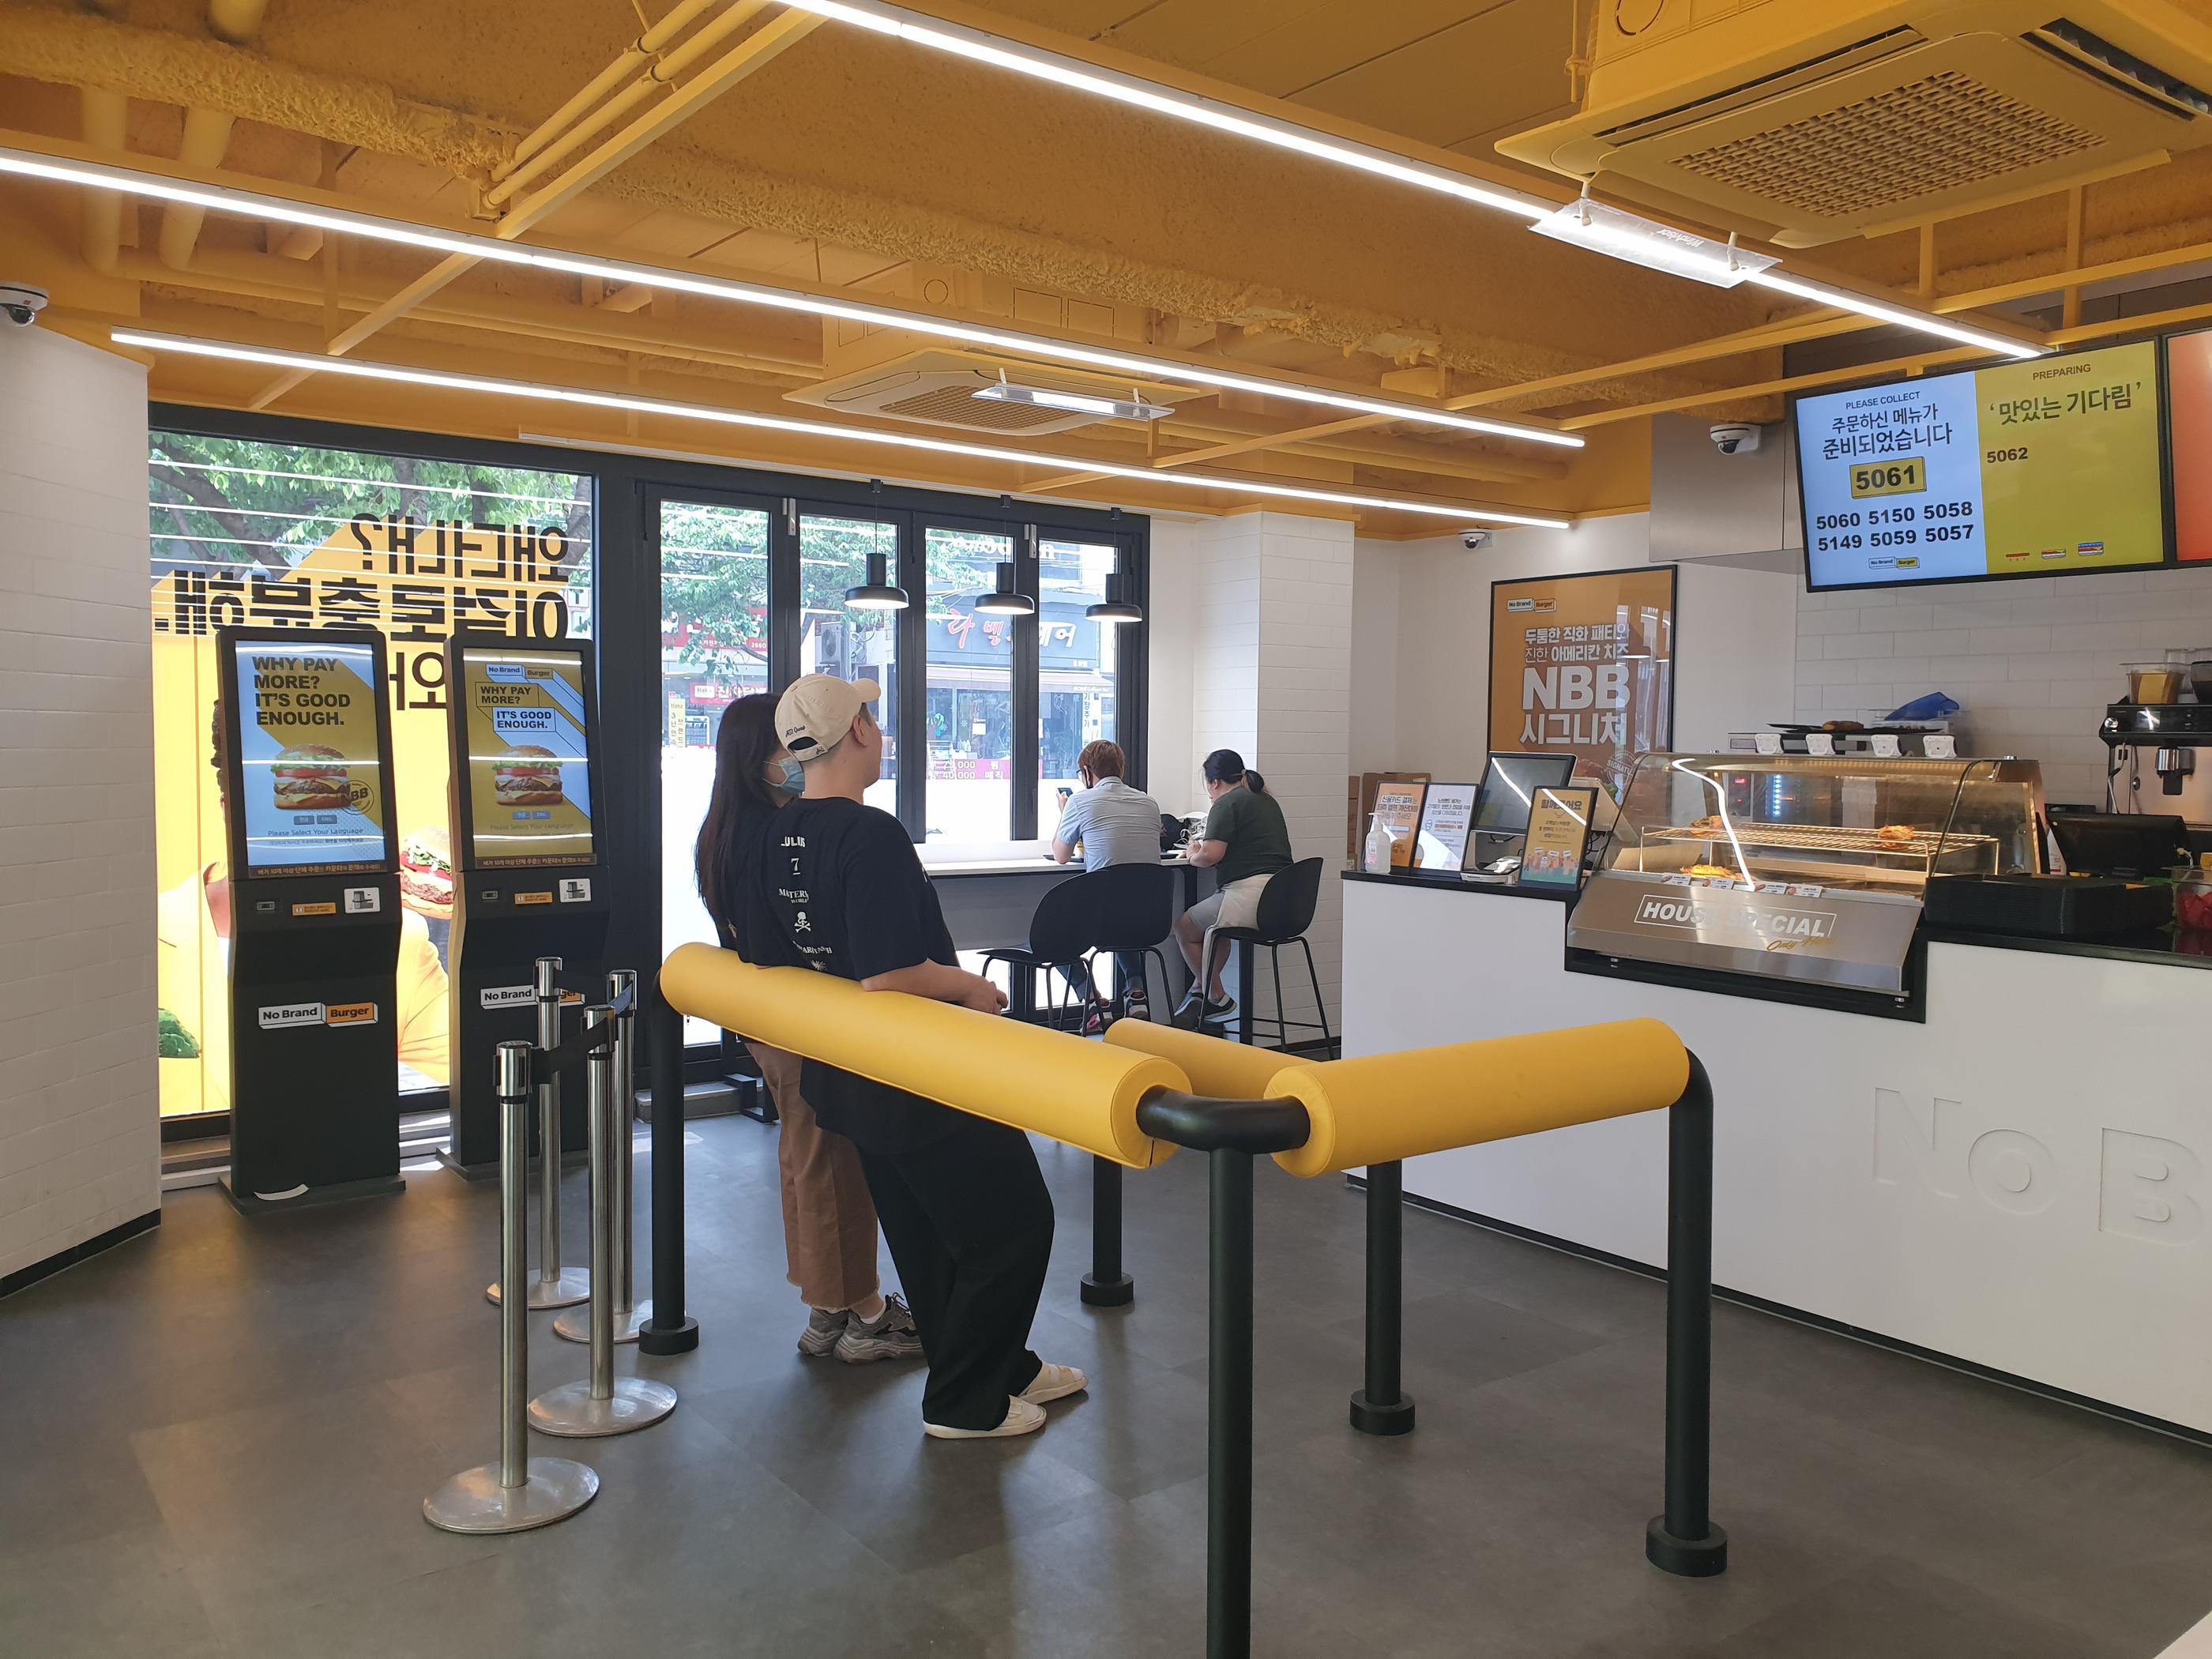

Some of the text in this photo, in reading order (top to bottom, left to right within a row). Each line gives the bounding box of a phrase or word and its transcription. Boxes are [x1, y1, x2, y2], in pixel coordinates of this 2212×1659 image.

[1656, 228, 1704, 247] Windvisor
[2032, 363, 2092, 381] PREPARING
[1845, 391, 1920, 409] PLEASE COLLECT
[1831, 403, 1939, 434] 주문하신 메뉴가
[1822, 422, 1953, 461] 준비되었습니다
[1986, 446, 2029, 464] 5062
[1856, 465, 1915, 491] 5061
[1816, 501, 1973, 530] 5060 5150 5058
[1818, 524, 1974, 552] 5149 5059 5057
[1525, 627, 1561, 645] 두툼한
[1563, 625, 1589, 642] 직화
[1525, 646, 1548, 664] 진한
[1551, 645, 1601, 662] 아메리칸
[252, 656, 338, 672] WHY PAY
[254, 675, 320, 689] MORE?
[527, 669, 550, 678] Burger
[480, 686, 532, 695] WHY PAY
[1522, 664, 1631, 711] NBB
[295, 694, 351, 708] GOOD
[481, 695, 521, 705] MORE?
[256, 711, 344, 726] ENOUGH.
[497, 720, 548, 729] ENOUGH.
[520, 711, 551, 720] GOOD
[1519, 712, 1627, 746] 시그니처
[330, 828, 364, 837] Language
[791, 857, 799, 872] 7
[484, 992, 499, 1001] No
[501, 988, 532, 999] Brand
[262, 1006, 370, 1020] No Brand Burger
[1872, 1086, 2057, 1217] NO
